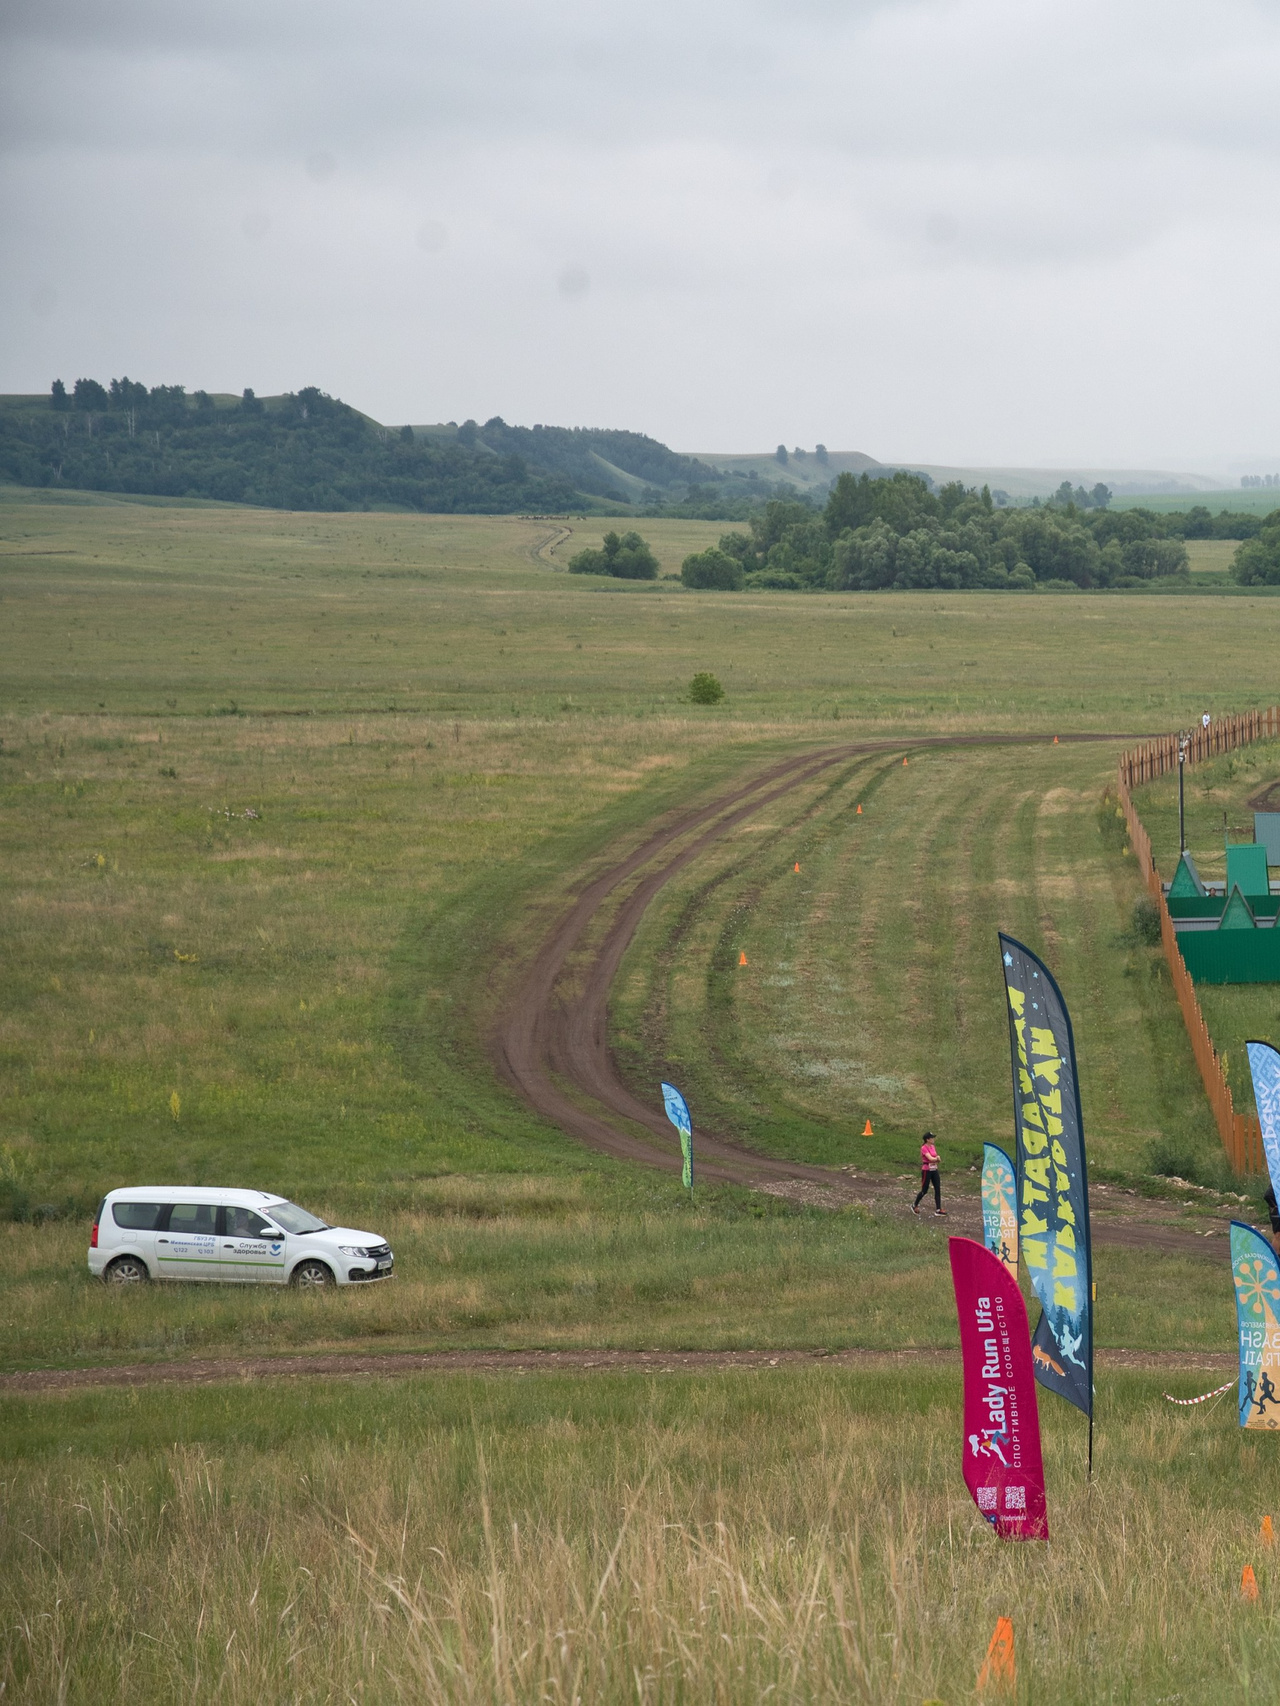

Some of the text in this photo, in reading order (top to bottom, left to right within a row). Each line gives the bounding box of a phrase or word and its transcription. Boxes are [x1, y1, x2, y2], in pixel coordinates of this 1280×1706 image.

[975, 1296, 1008, 1434] Lady Run Ufa
[994, 1296, 1022, 1469] СПОРТИВНОЕ СООБЩЕСТВО
